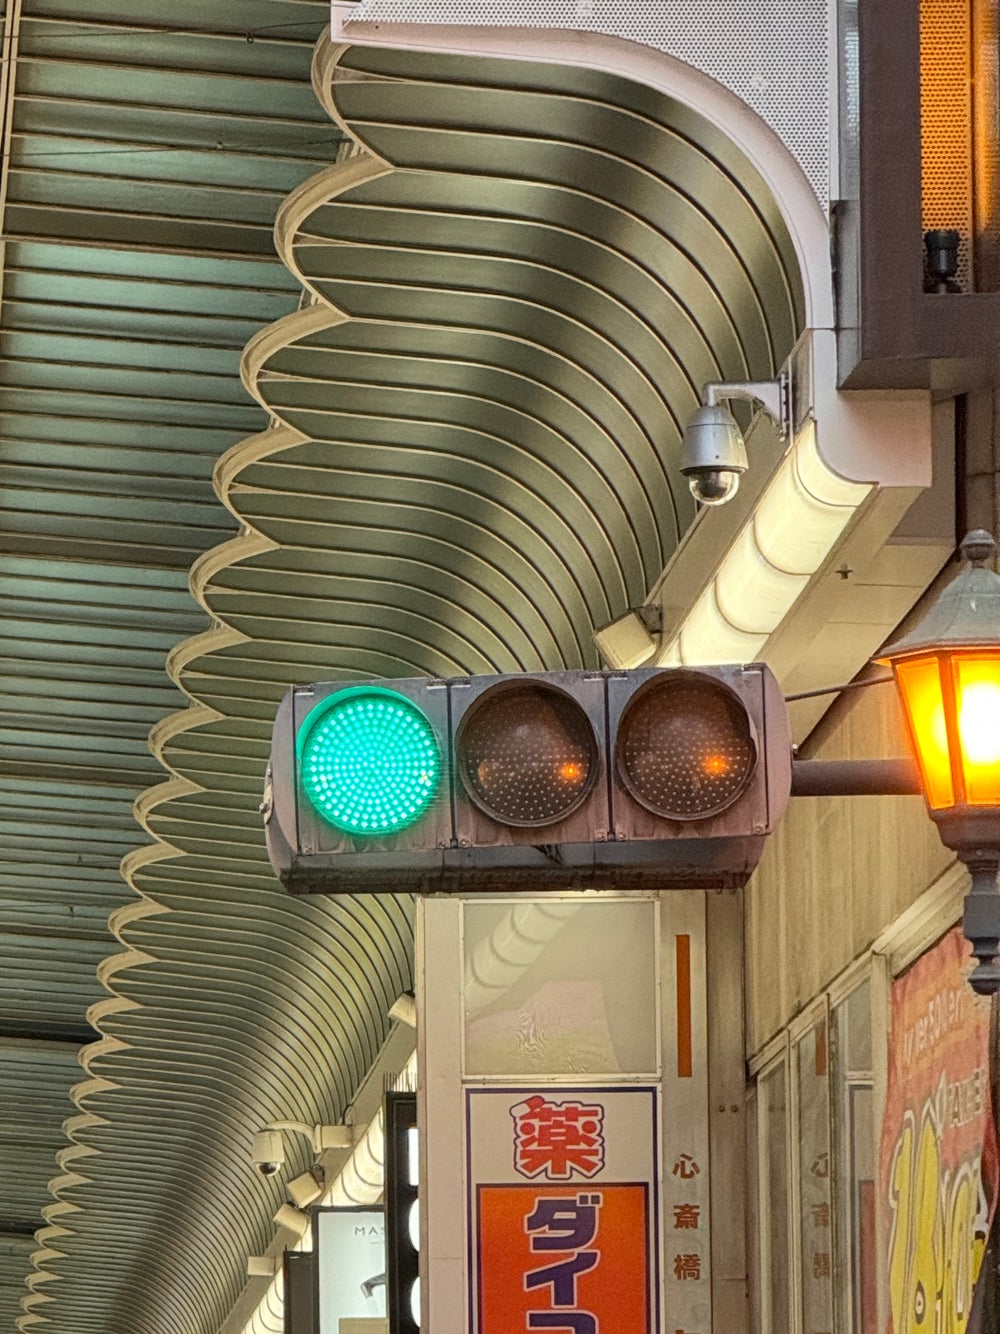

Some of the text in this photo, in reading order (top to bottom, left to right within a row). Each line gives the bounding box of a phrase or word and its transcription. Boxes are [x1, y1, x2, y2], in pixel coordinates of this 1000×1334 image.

[511, 1096, 605, 1179] 薬
[673, 1153, 701, 1281] 心斎橋
